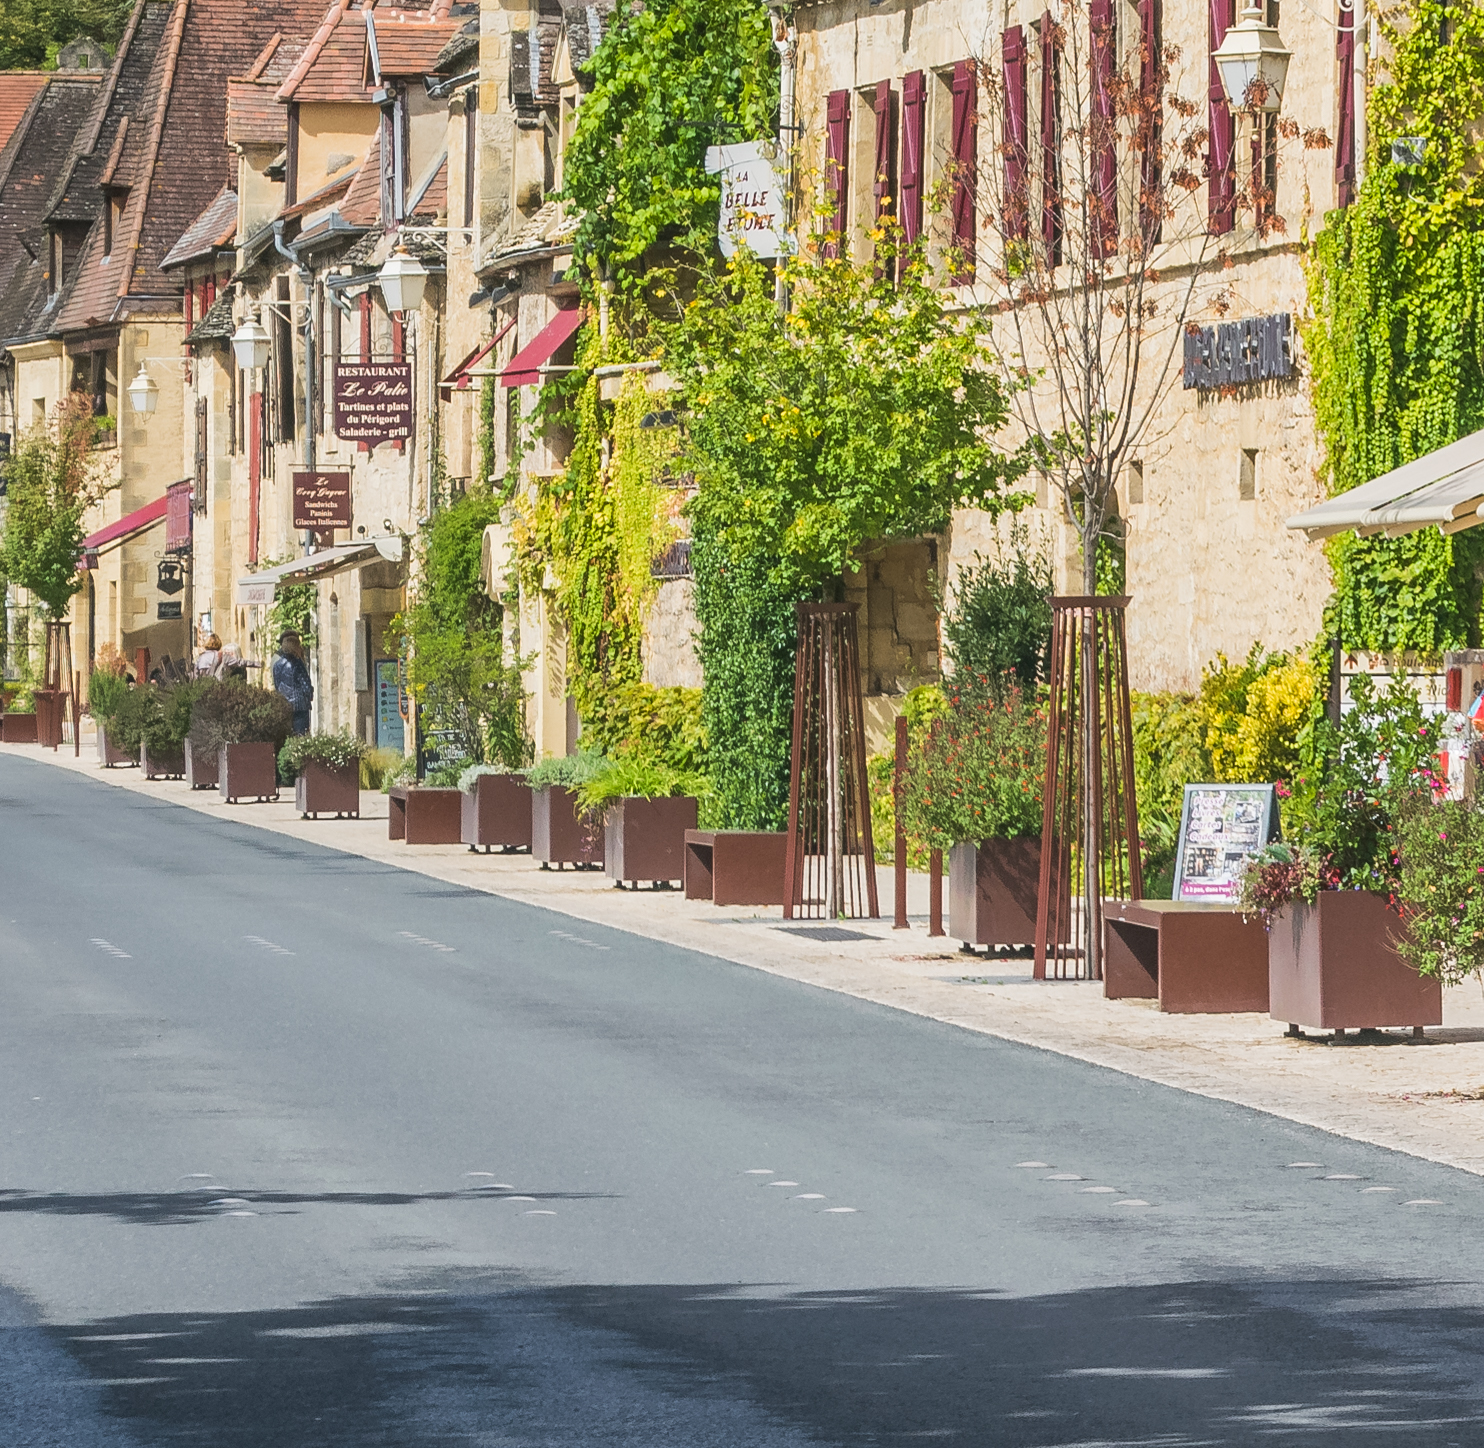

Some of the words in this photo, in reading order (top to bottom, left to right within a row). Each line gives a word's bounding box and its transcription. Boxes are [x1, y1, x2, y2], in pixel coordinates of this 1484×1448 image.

[725, 191, 769, 209] BELLE
[337, 367, 408, 376] RESTAURANT
[337, 381, 365, 397] Le
[338, 402, 375, 411] Tartines
[376, 403, 385, 411] et
[386, 402, 409, 413] plats
[346, 415, 359, 424] du
[360, 414, 400, 425] Périgord
[340, 427, 381, 436] Saladerie
[388, 427, 408, 438] grill
